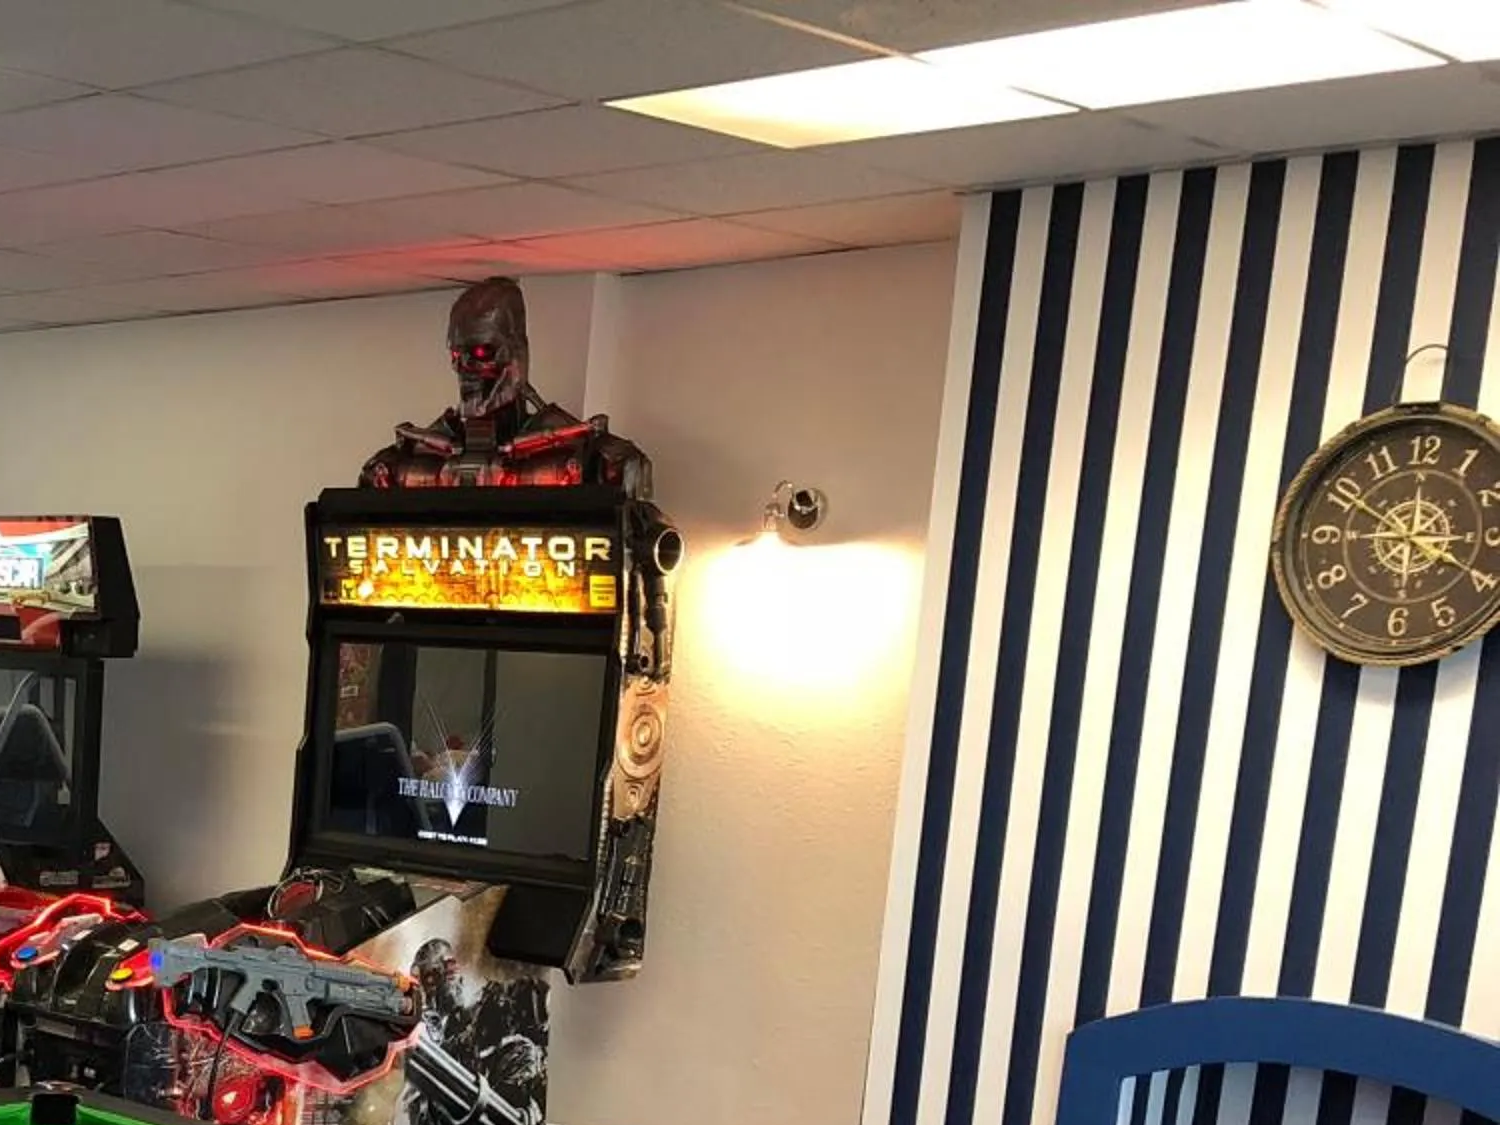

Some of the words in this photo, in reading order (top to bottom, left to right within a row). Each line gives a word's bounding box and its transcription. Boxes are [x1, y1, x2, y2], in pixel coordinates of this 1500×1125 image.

[1364, 445, 1399, 481] 11
[1408, 435, 1442, 466] 12
[1452, 449, 1479, 477] 1
[1327, 476, 1362, 513] 10
[324, 536, 612, 561] TERMINATOR
[1311, 525, 1341, 545] 9
[349, 559, 576, 577] SALVATION
[1318, 564, 1347, 590] 8
[1471, 569, 1498, 593] 4
[1341, 592, 1369, 619] 7
[1431, 596, 1456, 628] 5
[1387, 608, 1410, 637] 6
[398, 777, 419, 797] THE
[467, 785, 519, 807] COMPANY
